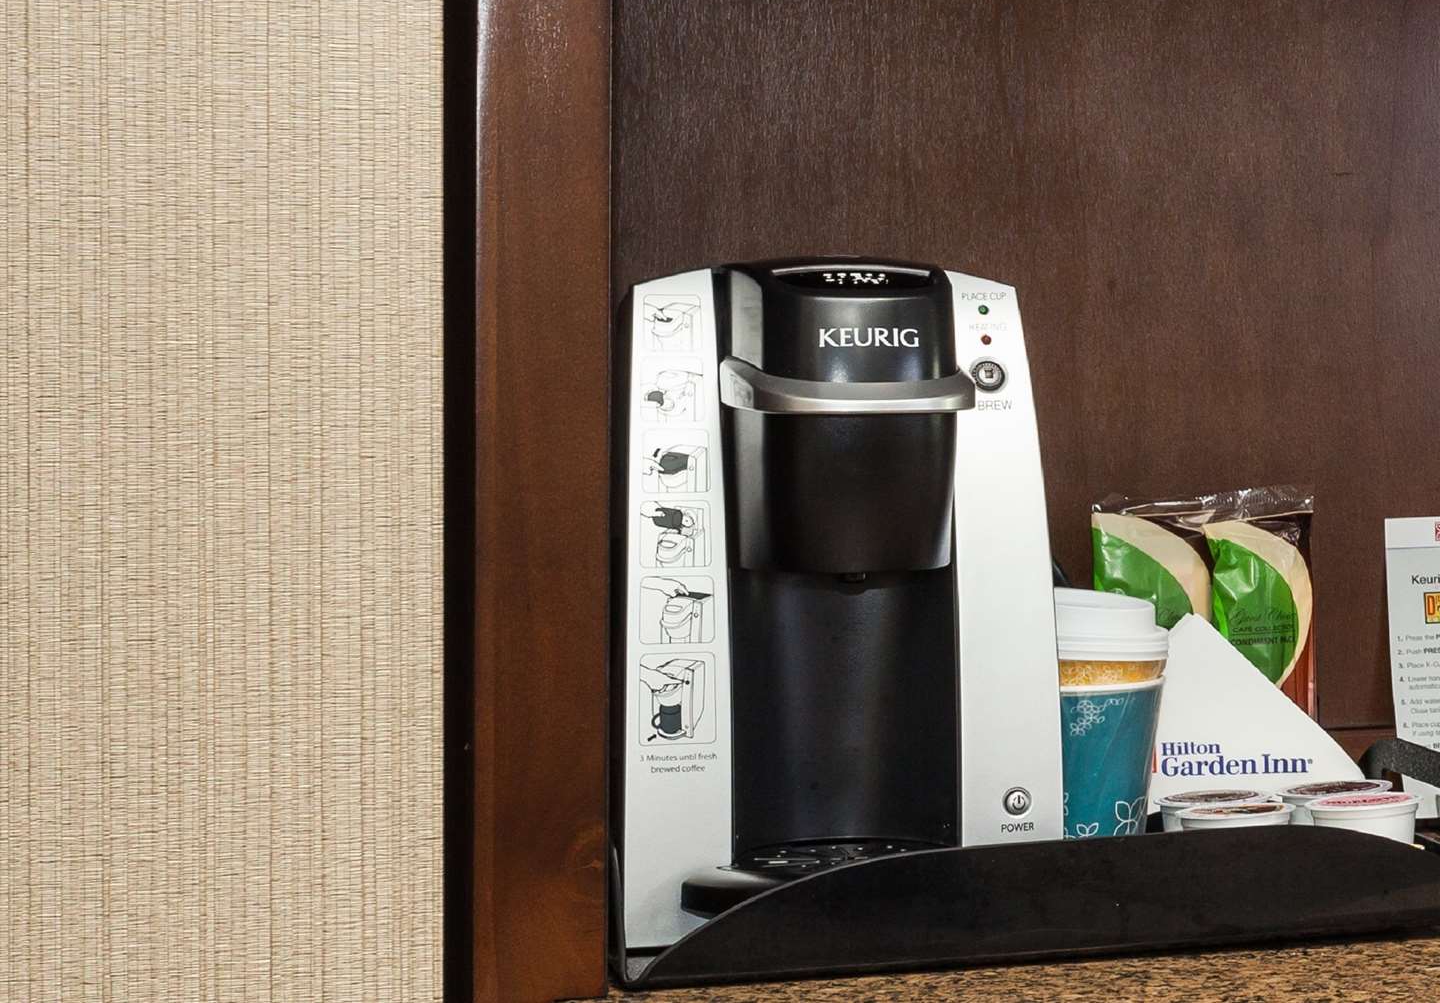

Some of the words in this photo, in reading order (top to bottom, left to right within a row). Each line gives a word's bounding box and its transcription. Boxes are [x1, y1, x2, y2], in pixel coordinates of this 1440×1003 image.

[962, 292, 988, 301] PLACE
[990, 292, 1007, 300] CUP
[819, 327, 919, 347] KEURIG
[977, 400, 1012, 411] BREW
[1161, 742, 1221, 757] Hilton
[640, 754, 645, 762] 3
[646, 754, 678, 762] Minutes
[679, 753, 697, 761] until
[698, 752, 718, 761] fresh
[651, 765, 680, 774] brewed
[681, 764, 706, 773] coffee
[1161, 755, 1256, 777] Garden
[1001, 822, 1034, 833] POWER
